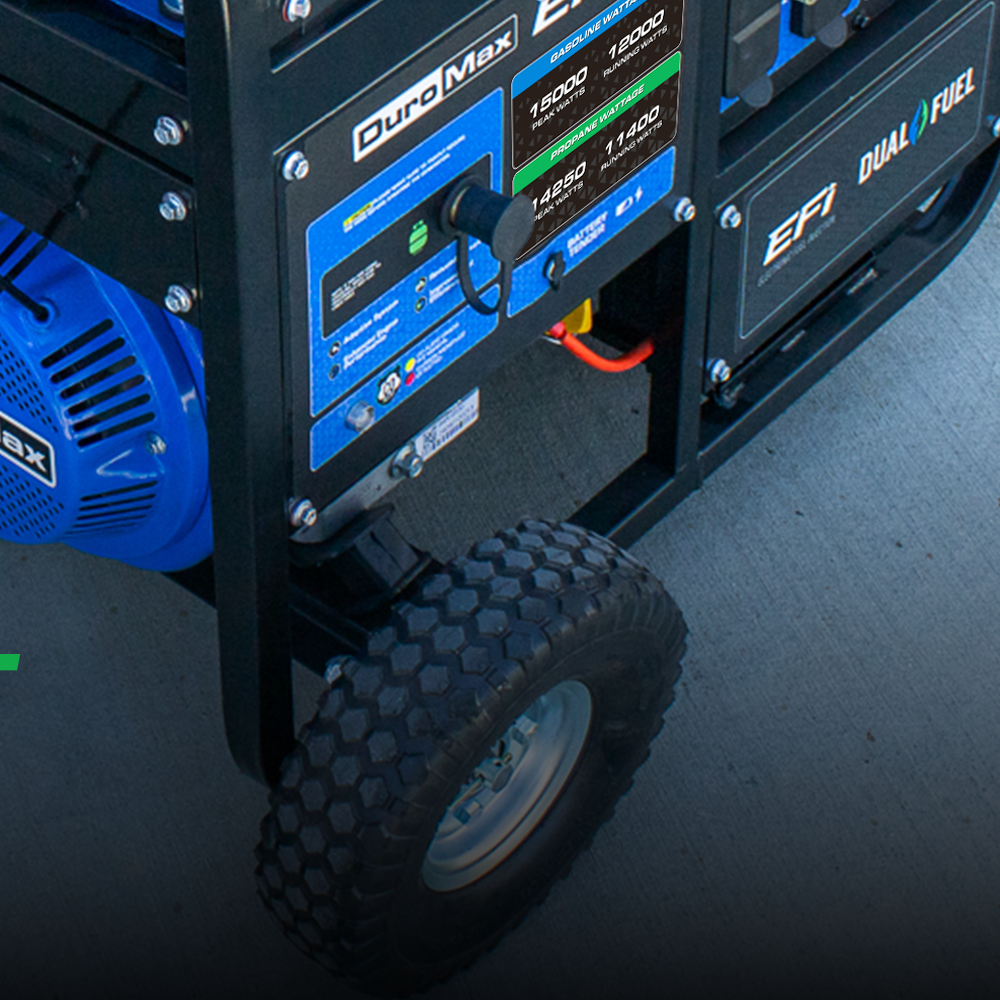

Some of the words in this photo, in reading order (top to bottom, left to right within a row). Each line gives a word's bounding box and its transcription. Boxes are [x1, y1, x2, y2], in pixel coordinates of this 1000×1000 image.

[550, 20, 601, 64] GASOLINE
[603, 46, 640, 78] RUNNING
[641, 25, 668, 50] WATTS
[608, 9, 665, 60] 12000
[355, 21, 515, 155] DuroMax
[530, 66, 588, 119] 15000
[532, 111, 555, 131] PEAK
[556, 86, 586, 113] WATTS
[550, 119, 598, 161] PROPANE
[600, 83, 646, 124] WATTAGE
[601, 141, 636, 172] RUNNING
[637, 120, 663, 145] WATTS
[605, 105, 660, 156] 11400
[858, 121, 909, 185] DUAL
[930, 67, 975, 124] FUEL
[532, 161, 587, 211] 14250
[556, 180, 584, 207] WATTS
[567, 211, 608, 248] BATTERY
[569, 223, 606, 257] TENDER
